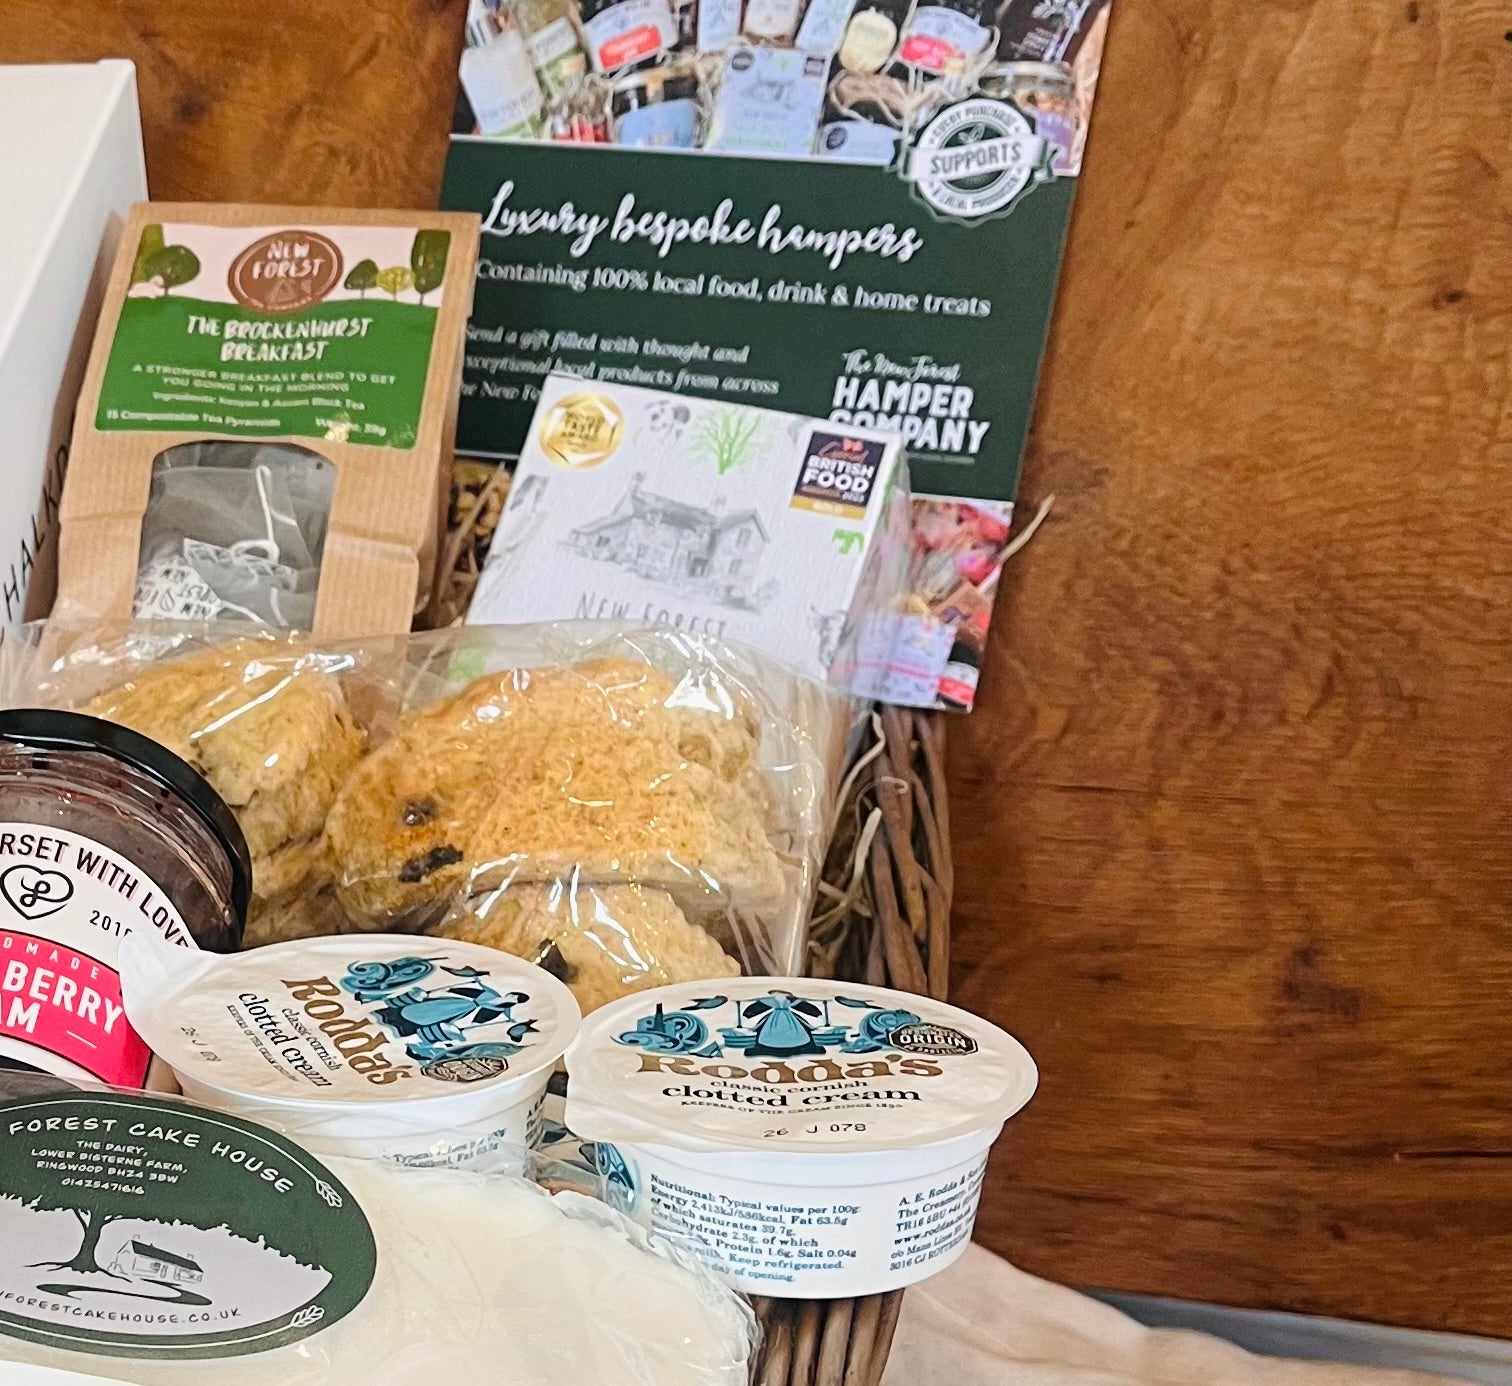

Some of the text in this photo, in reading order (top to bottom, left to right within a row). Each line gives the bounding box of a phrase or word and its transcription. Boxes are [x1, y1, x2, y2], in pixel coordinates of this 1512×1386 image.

[931, 142, 1022, 175] SUPPORTS
[481, 180, 924, 271] Luxury bespoke hampers
[267, 240, 310, 259] NEW
[252, 258, 326, 280] FOREST
[477, 258, 991, 318] Containing 100% local food, drink & home treats
[188, 315, 374, 340] THE BROCKENHURST
[220, 340, 329, 362] BREAKFAST
[551, 329, 598, 353] filled
[598, 336, 640, 354] with
[712, 344, 751, 364] and
[146, 364, 217, 380] STRONGER
[349, 371, 367, 382] TO
[370, 374, 396, 385] GET
[163, 376, 190, 387] YOU
[239, 382, 254, 393] IN
[257, 382, 283, 394] THE
[597, 364, 780, 395] products from across
[831, 375, 975, 419] HAMPER
[807, 454, 875, 479] BRITISH
[801, 468, 870, 493] FOOD
[76, 847, 139, 900] WITH
[2, 960, 125, 1035] BERRY
[238, 992, 299, 1046] clotted
[281, 1046, 333, 1087] cream
[280, 976, 414, 1086] Rodda's
[281, 1007, 314, 1040] classic
[305, 1035, 343, 1072] cornish
[899, 1034, 967, 1049] ORIGIN
[636, 1052, 945, 1084] Rodda's
[662, 1085, 923, 1107] clotted cream
[710, 1079, 869, 1094] classic cornish
[763, 1122, 868, 1138] 26 J 078
[8, 1116, 118, 1136] FOREST
[128, 1122, 201, 1148] CAKE
[209, 1141, 295, 1195] HOUSE
[75, 1139, 149, 1157] THE DAIRY,
[31, 1148, 189, 1175] LOWER BISTERNE FARM,
[36, 1159, 104, 1174] RINGWOOD
[107, 1166, 145, 1179] BH24
[61, 1176, 146, 1195] 01425471616
[928, 1180, 958, 1199] Rodda
[650, 1184, 814, 1225] Energy Fat
[718, 1194, 763, 1211] Typical
[765, 1204, 804, 1214] values
[807, 1206, 827, 1216] per
[898, 1208, 919, 1220] The
[663, 1202, 758, 1232] which saturates
[715, 1238, 857, 1259] Protein Salt 0.04g
[761, 1235, 777, 1245] of
[778, 1237, 820, 1247] which
[728, 1252, 845, 1271] Keep refrigerated.
[734, 1267, 745, 1277] of
